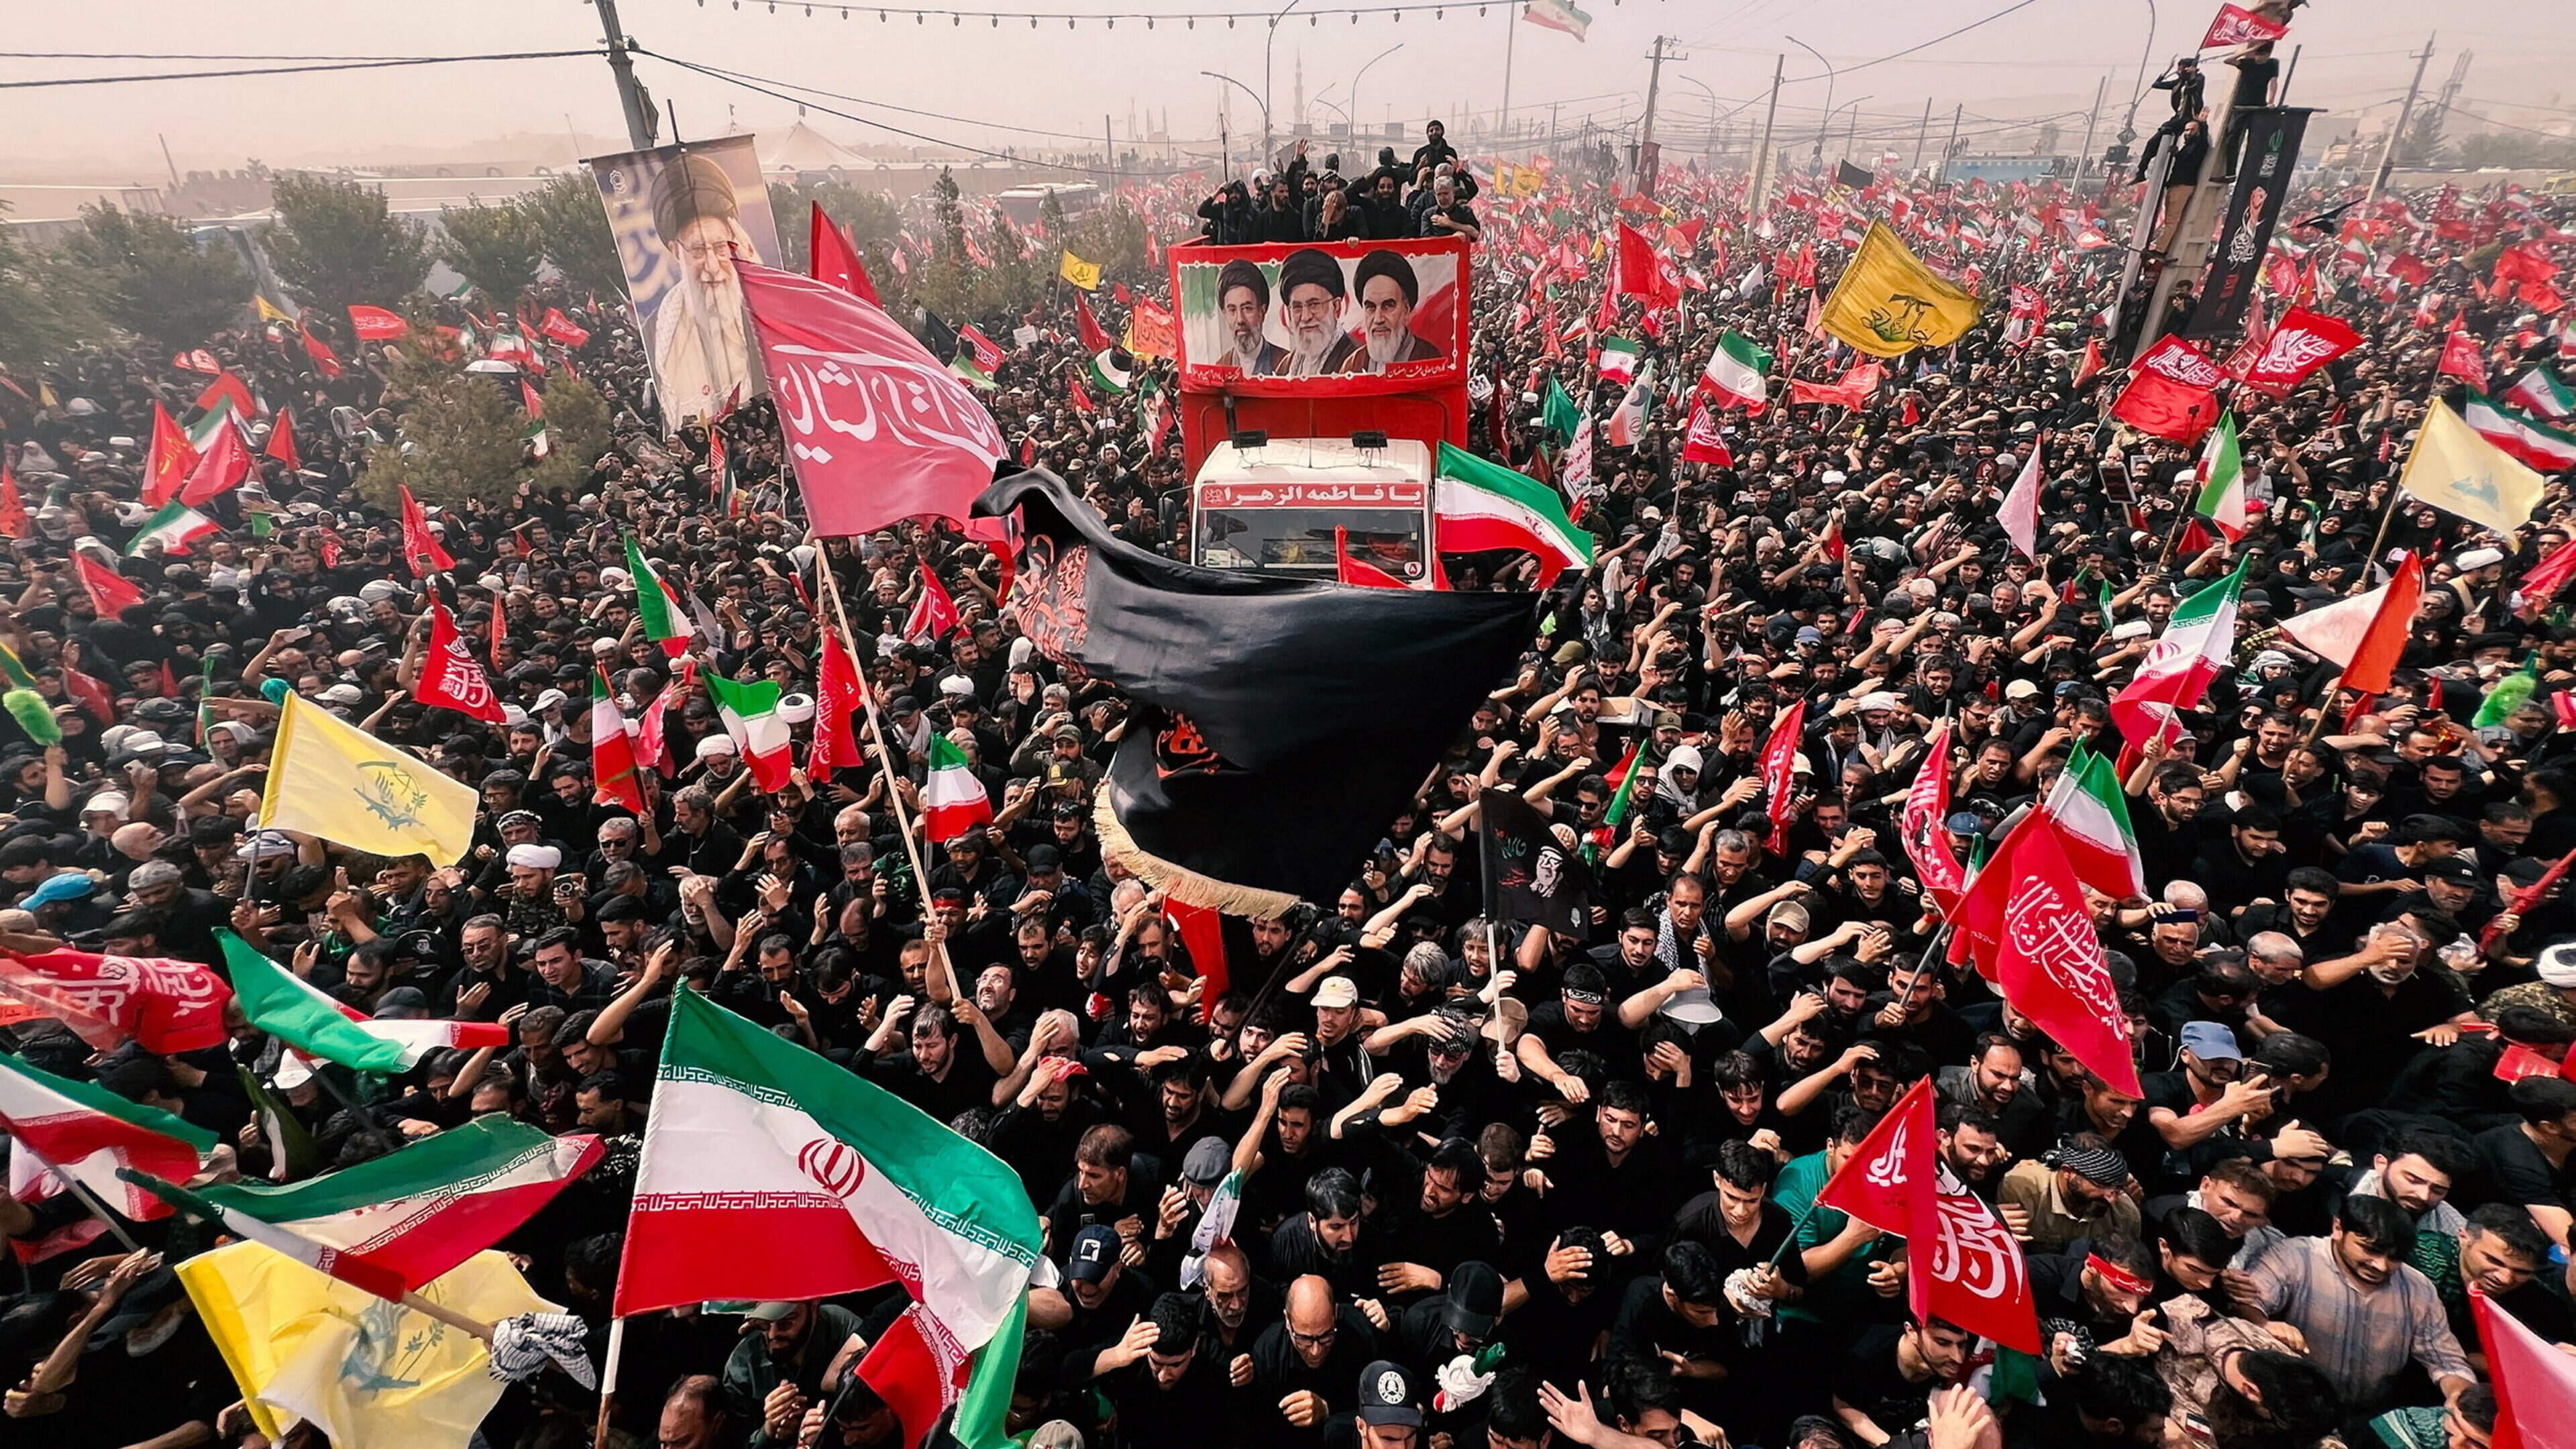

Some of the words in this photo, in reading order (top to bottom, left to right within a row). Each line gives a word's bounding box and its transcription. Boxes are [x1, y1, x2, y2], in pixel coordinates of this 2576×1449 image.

[1224, 486, 1303, 506] الزهرا
[1307, 484, 1384, 501] فاطمه
[1388, 485, 1421, 504] یا
